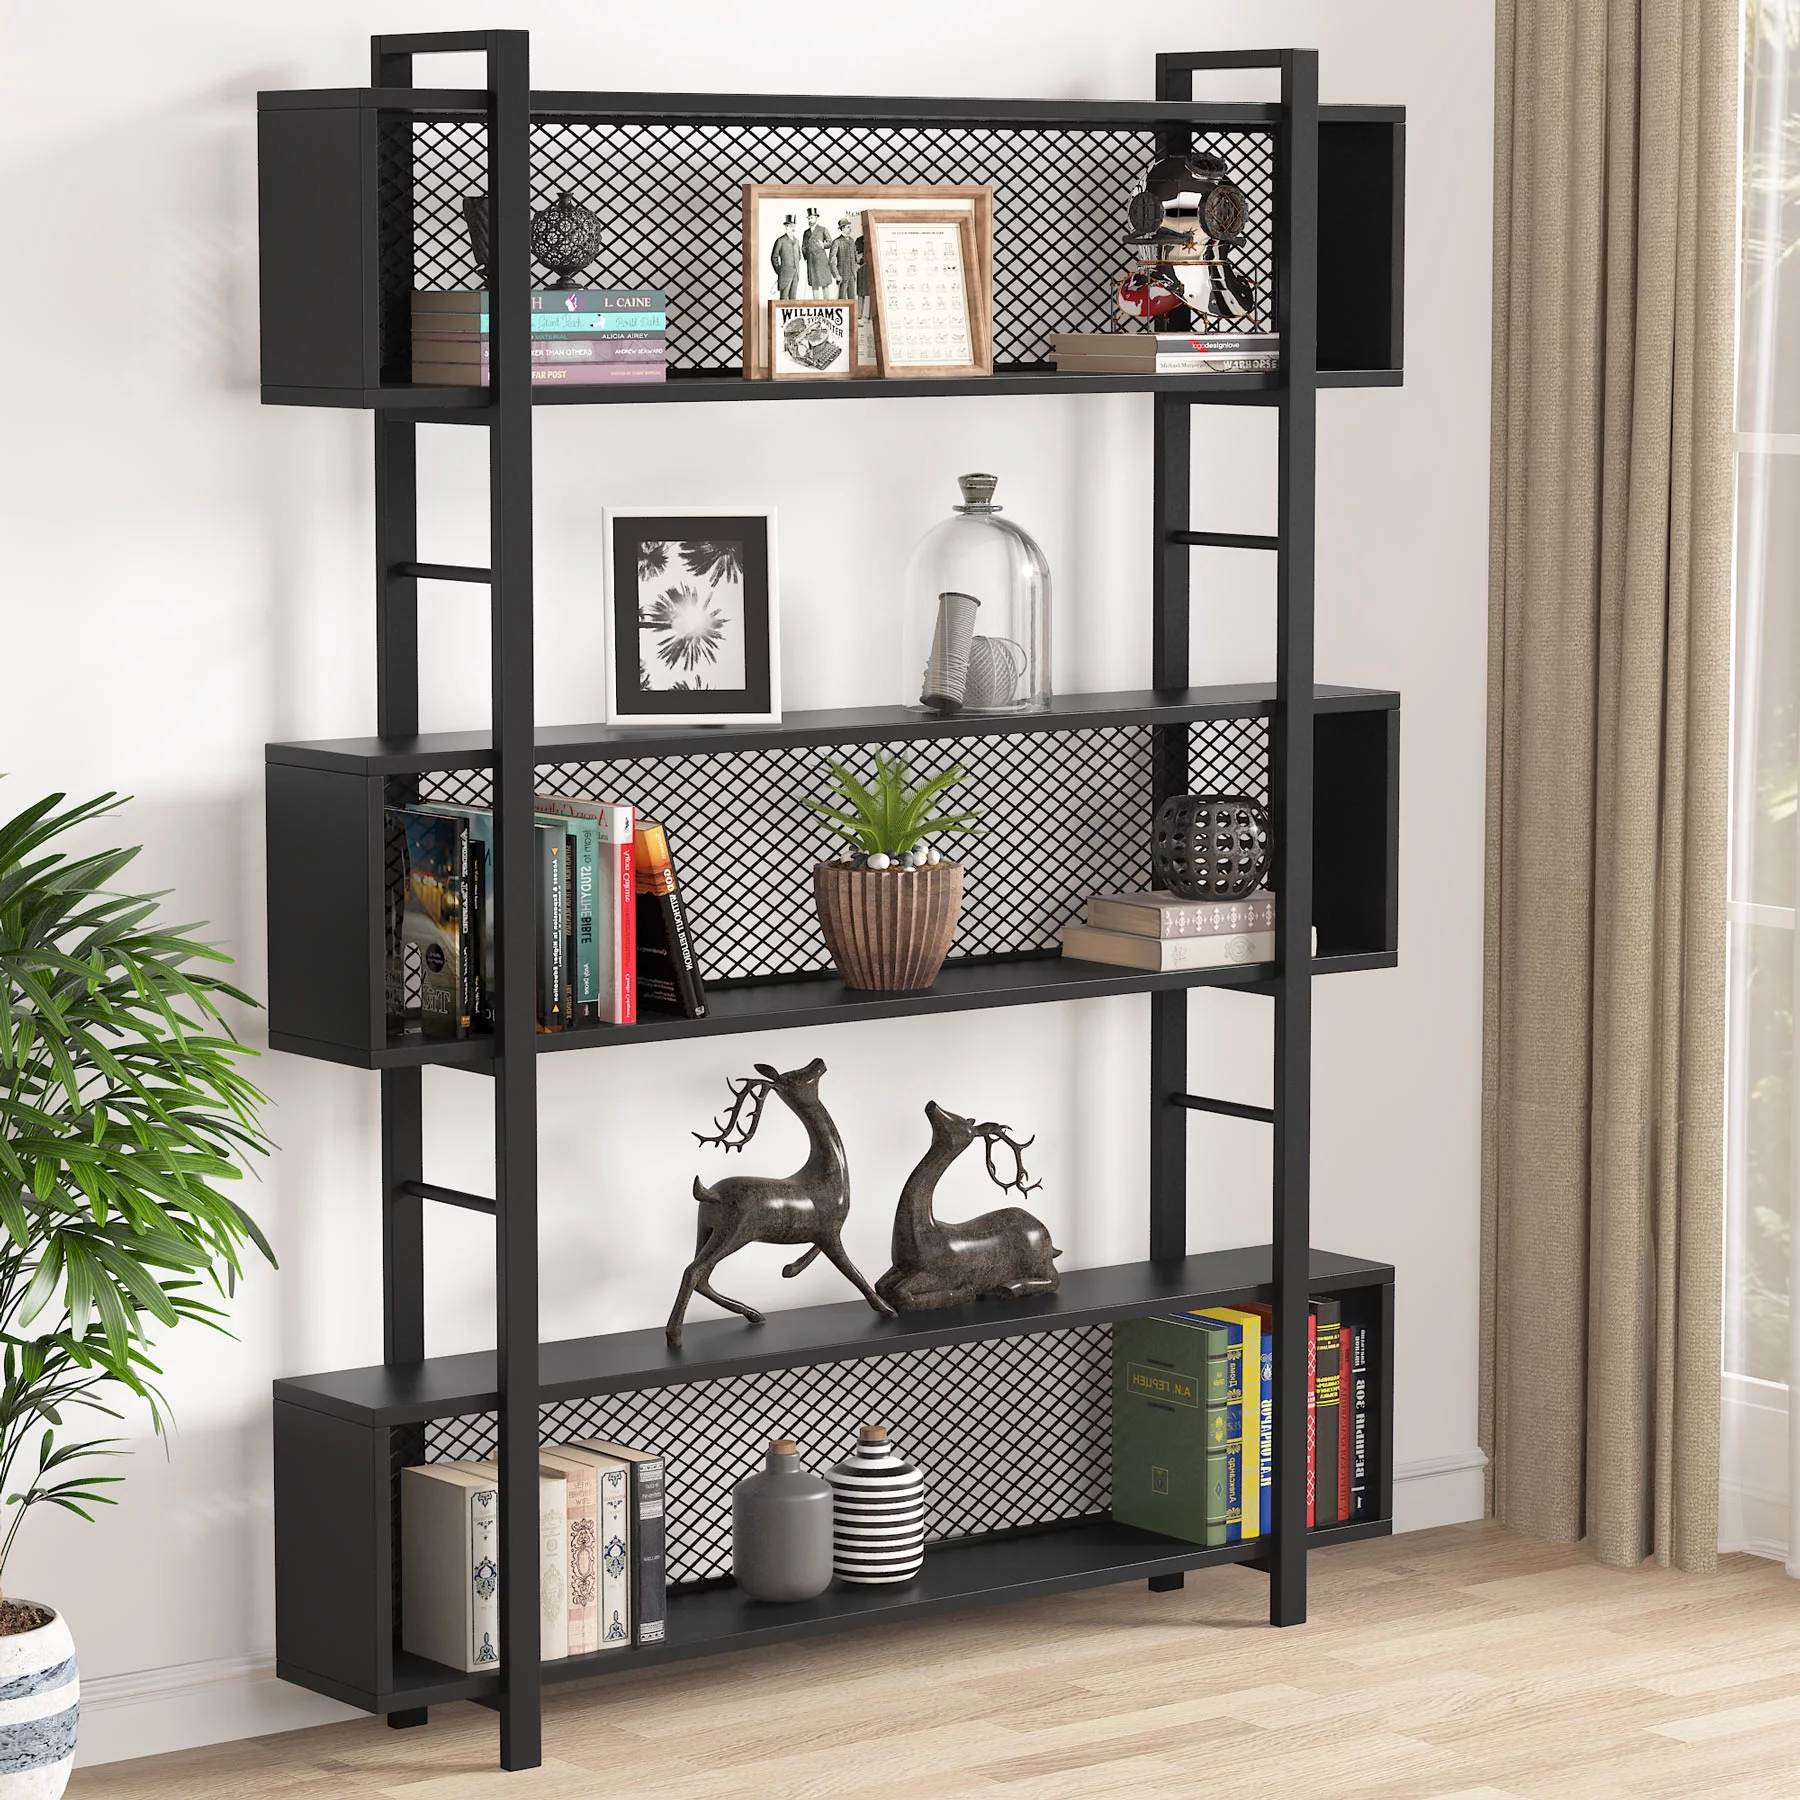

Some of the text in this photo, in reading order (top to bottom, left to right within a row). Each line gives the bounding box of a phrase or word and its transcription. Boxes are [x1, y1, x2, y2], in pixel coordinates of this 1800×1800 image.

[604, 297, 652, 308] L. CAINE
[640, 316, 661, 328] Dahl
[781, 308, 844, 326] WILLIAMS
[807, 317, 844, 338] TYPEWRITER
[1192, 341, 1241, 351] logodesignlove
[546, 348, 565, 356] THAN
[566, 348, 593, 357] OTHERS
[1160, 362, 1181, 370] Michael
[531, 370, 568, 379] FAR POST
